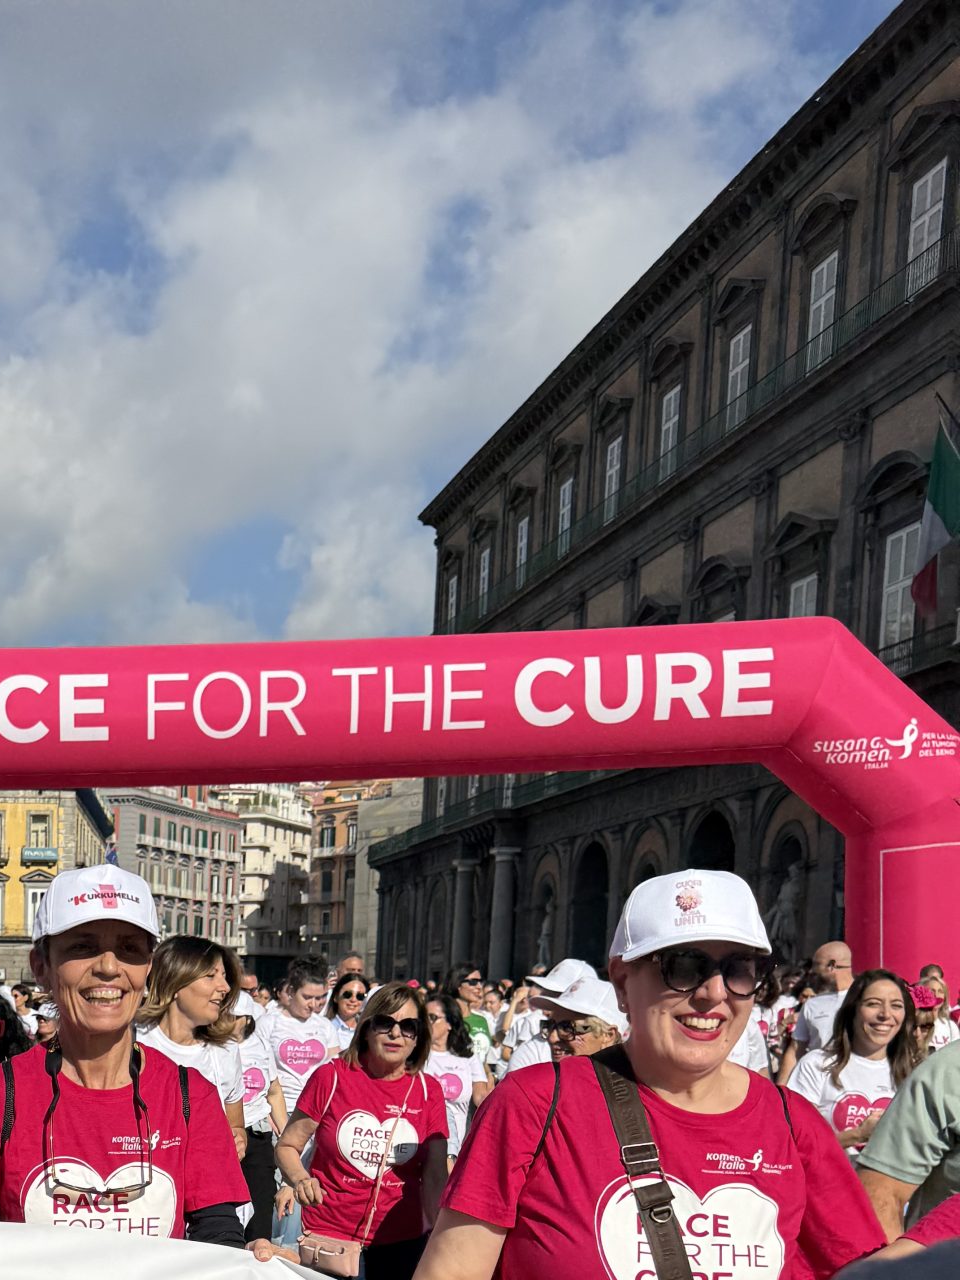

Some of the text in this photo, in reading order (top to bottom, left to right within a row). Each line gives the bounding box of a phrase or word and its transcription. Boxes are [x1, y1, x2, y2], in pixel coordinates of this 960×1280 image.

[147, 670, 307, 740] FOR
[331, 663, 486, 734] THE
[514, 647, 774, 727] CURE
[352, 1138, 380, 1150] FOR
[53, 1193, 129, 1214] RACE
[711, 1244, 768, 1268] THE
